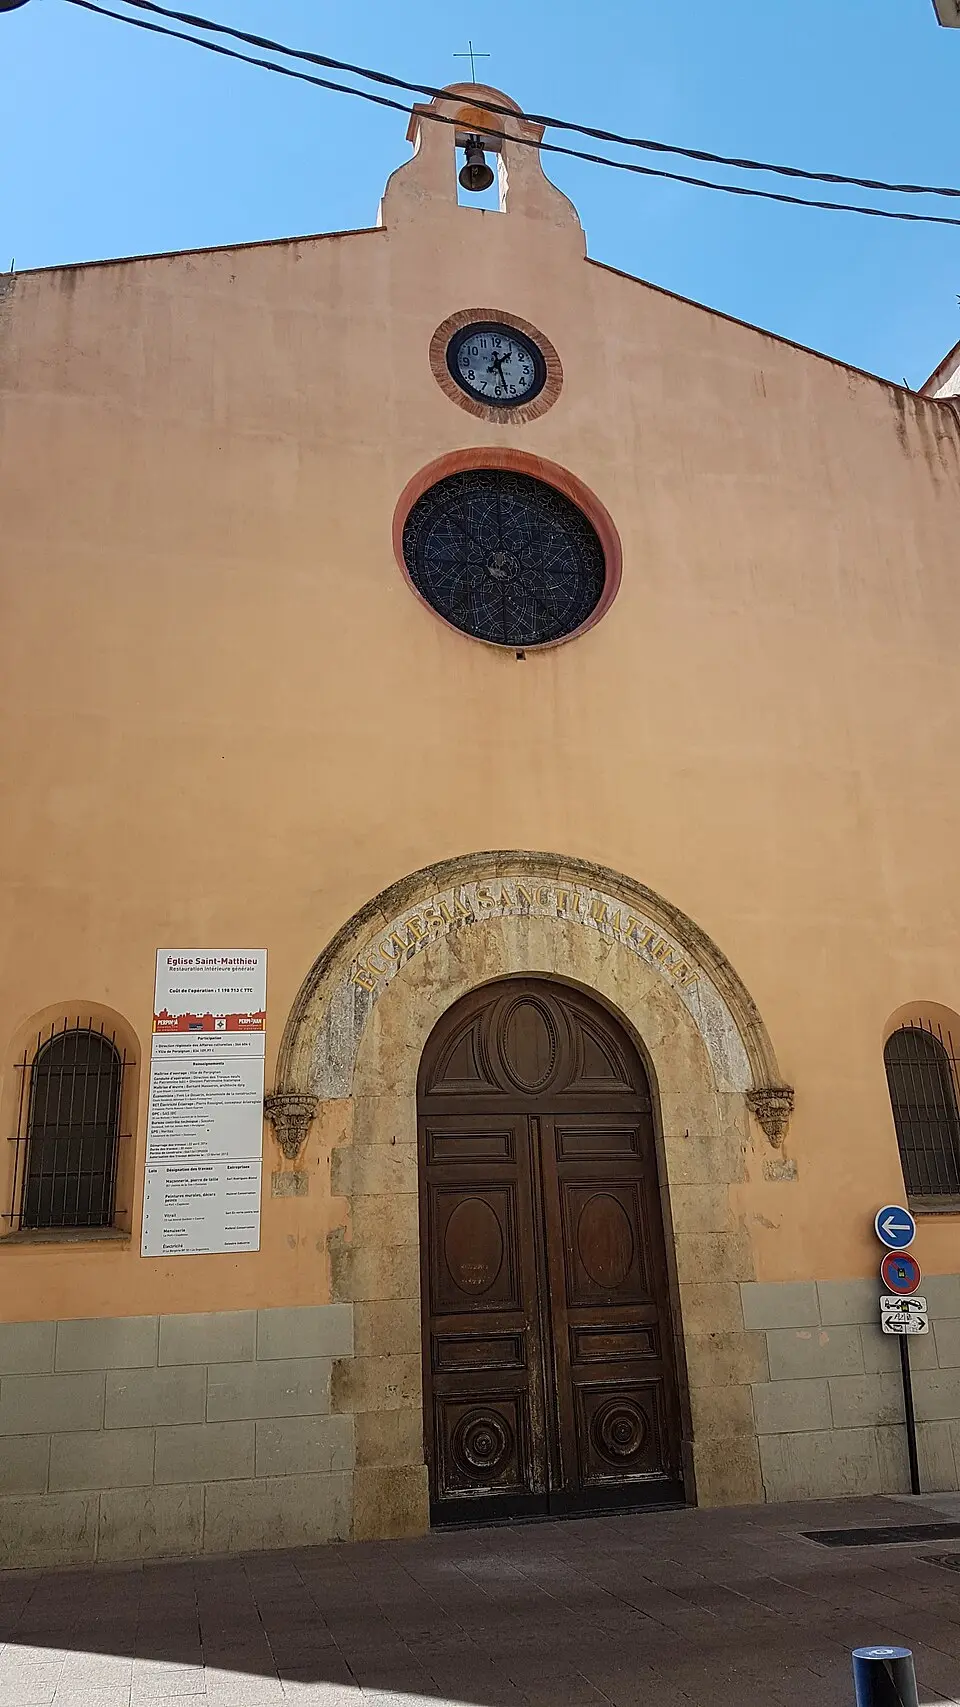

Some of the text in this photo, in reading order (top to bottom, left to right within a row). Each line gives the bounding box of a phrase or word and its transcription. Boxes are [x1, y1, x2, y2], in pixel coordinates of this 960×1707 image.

[480, 339, 486, 348] 11
[492, 338, 501, 348] 12
[468, 346, 478, 355] 10
[463, 358, 470, 366] 9
[518, 353, 524, 362] 2
[523, 365, 529, 374] 3
[468, 370, 475, 380] 8
[480, 381, 487, 390] 7
[519, 377, 526, 386] 4
[495, 386, 501, 396] 6
[510, 385, 516, 394] 5
[352, 884, 700, 992] ECCLESIA SANCTI MATTHEI
[167, 956, 193, 966] Église
